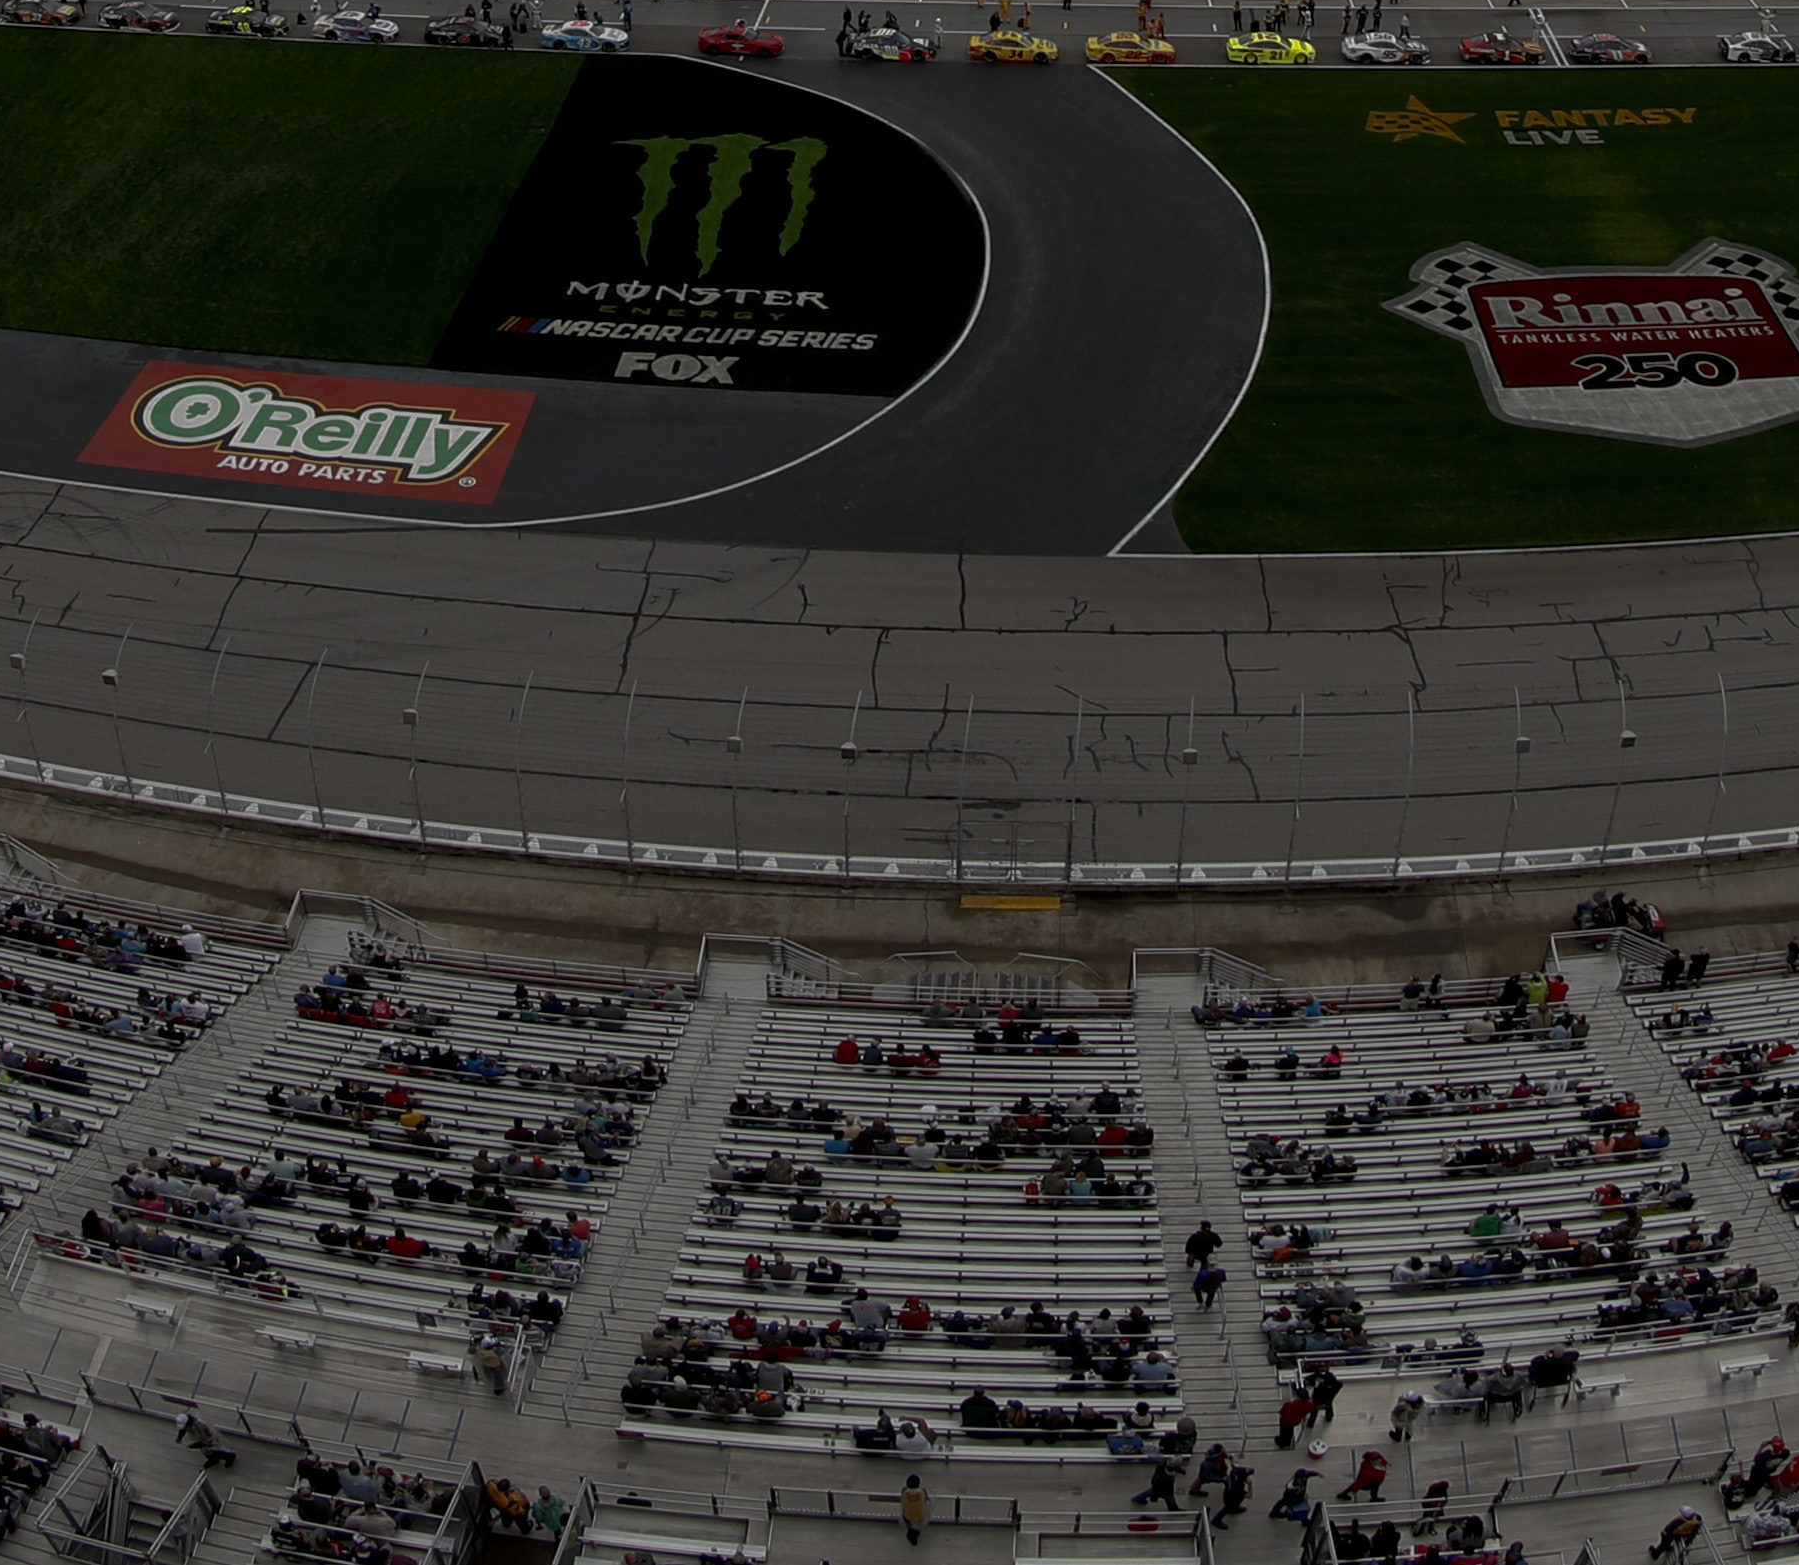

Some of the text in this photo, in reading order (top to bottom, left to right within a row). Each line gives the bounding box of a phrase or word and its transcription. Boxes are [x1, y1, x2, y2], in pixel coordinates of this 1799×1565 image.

[576, 38, 591, 48] 43
[1009, 49, 1024, 59] 34
[1124, 50, 1142, 59] 22
[1270, 51, 1283, 61] 21
[1382, 50, 1397, 59] 95
[1610, 49, 1623, 62] 11
[1494, 107, 1698, 127] FANTASY
[1501, 128, 1605, 147] LIVE
[565, 279, 830, 310] MONSTER
[598, 304, 787, 322] ENERGY
[1481, 287, 1765, 330] Rinnai
[544, 318, 879, 351] NASCAR CUP SERIES
[1498, 325, 1776, 345] TANKLESS WATER HEATERS
[613, 351, 741, 385] FOX
[1570, 352, 1740, 390] 250
[140, 379, 495, 480] O'Reilly
[216, 453, 387, 485] AUTO PARTS
